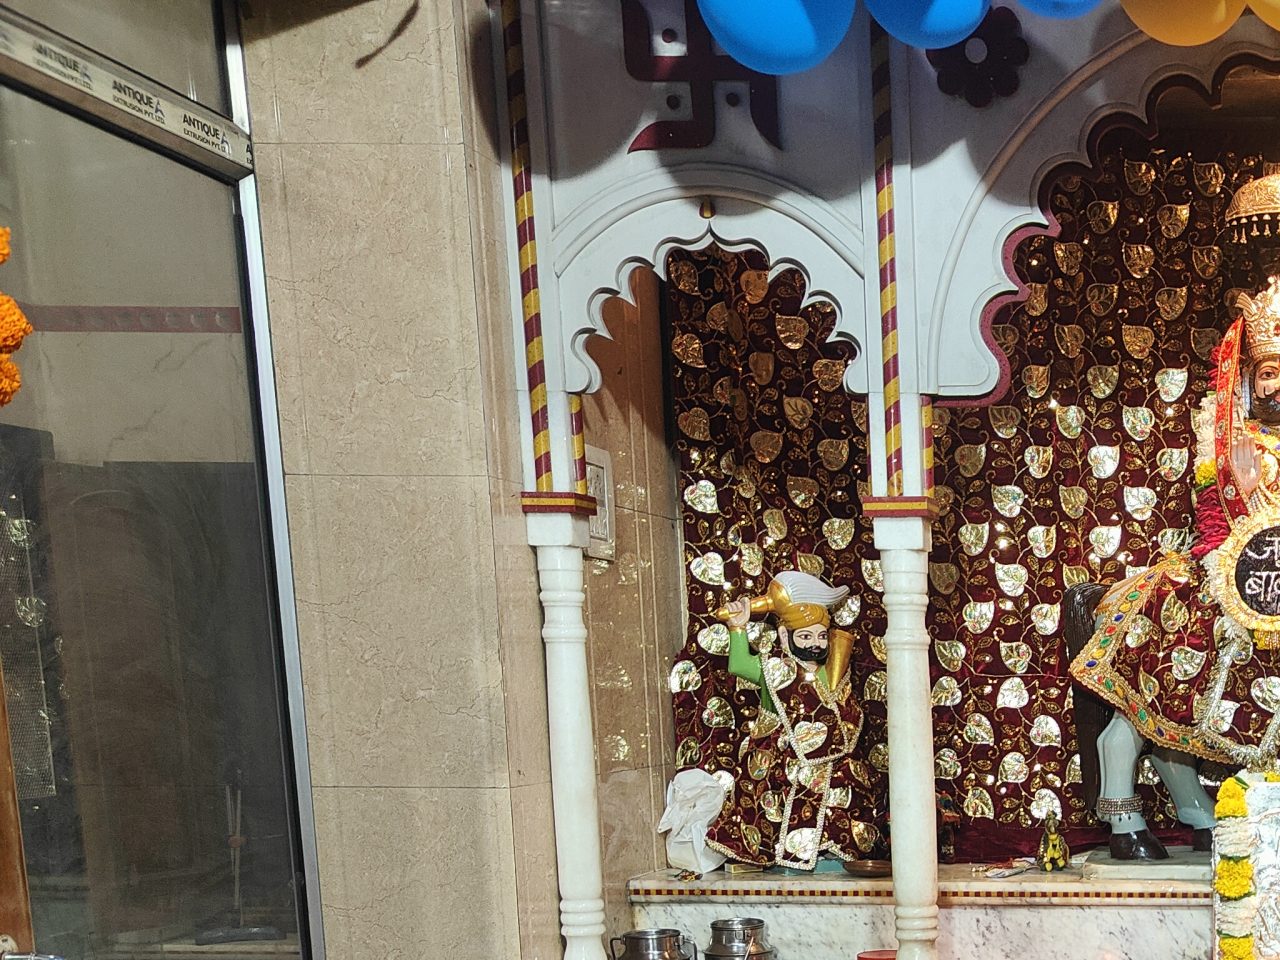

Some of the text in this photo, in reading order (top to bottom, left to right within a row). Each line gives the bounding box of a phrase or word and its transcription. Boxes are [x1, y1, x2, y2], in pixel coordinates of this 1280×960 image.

[112, 80, 154, 108] ANTIQUE
[183, 114, 220, 139] ANTIQUE
[183, 128, 211, 146] EXTRUSION
